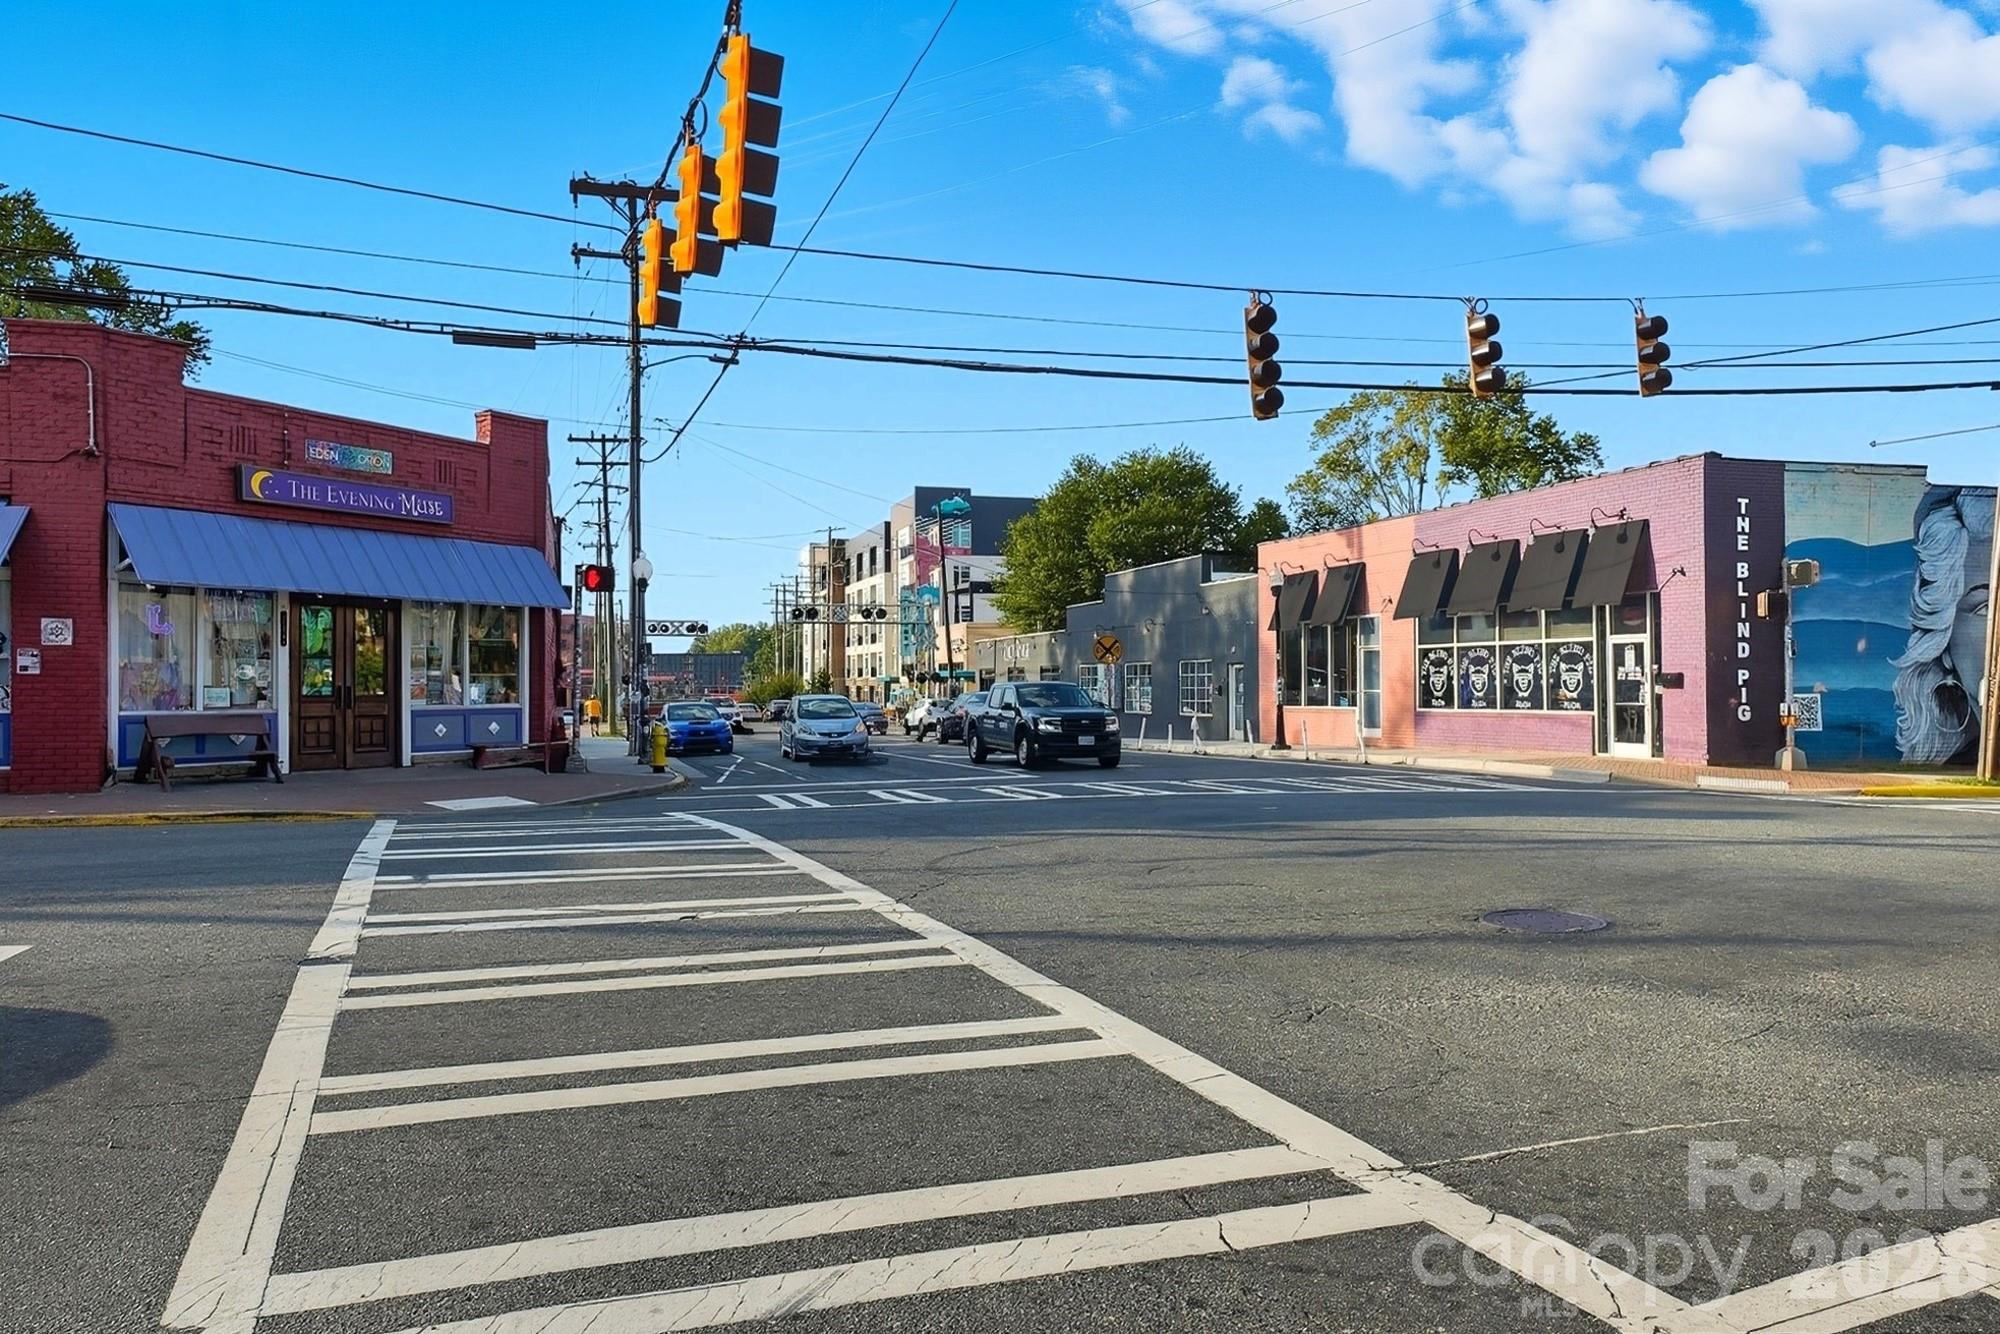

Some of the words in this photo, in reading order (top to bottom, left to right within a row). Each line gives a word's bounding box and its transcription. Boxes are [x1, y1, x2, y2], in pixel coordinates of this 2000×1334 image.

[288, 480, 321, 501] THE
[327, 485, 395, 510] EVENING
[1736, 562, 1750, 658] BLIND
[1737, 669, 1752, 722] PIG
